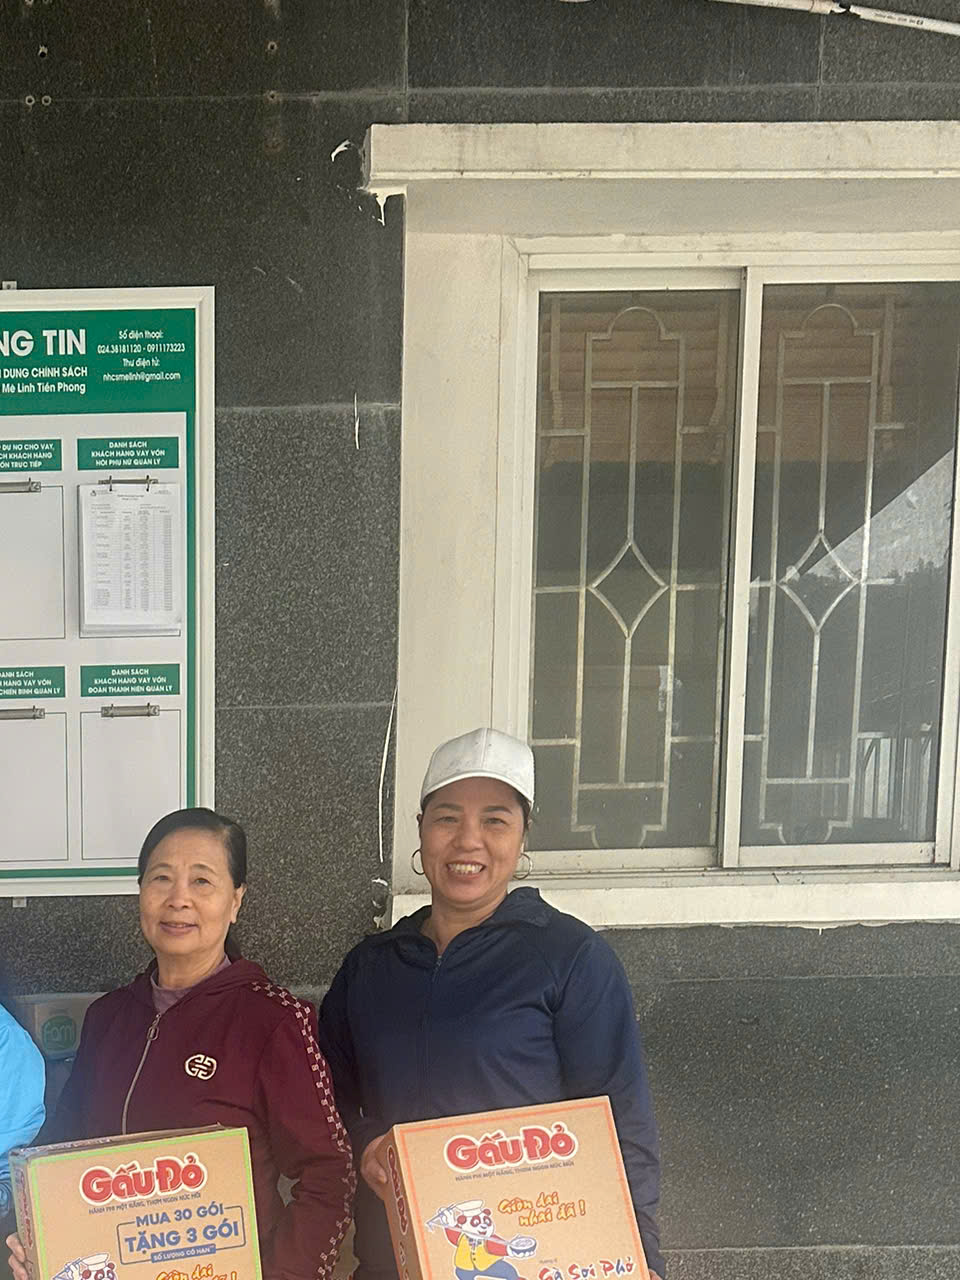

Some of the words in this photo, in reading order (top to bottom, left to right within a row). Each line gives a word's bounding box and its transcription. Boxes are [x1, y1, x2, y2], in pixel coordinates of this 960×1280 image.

[42, 329, 86, 355] TIN
[61, 365, 88, 377] SÁCH
[17, 383, 35, 393] Linh
[57, 382, 86, 395] Phong
[447, 1130, 523, 1170] Gấu
[523, 1124, 575, 1161] Đỏ
[82, 1163, 155, 1203] Gấu
[156, 1155, 204, 1193] Đỏ
[536, 1191, 559, 1208] dai
[135, 1211, 171, 1227] MUA
[174, 1208, 192, 1222] 30
[197, 1201, 224, 1218] GÓI
[124, 1230, 181, 1255] TẶNG
[186, 1227, 197, 1243] 3
[203, 1218, 239, 1240] GÓI
[192, 1263, 213, 1280] dai
[600, 1256, 634, 1276] Phở
